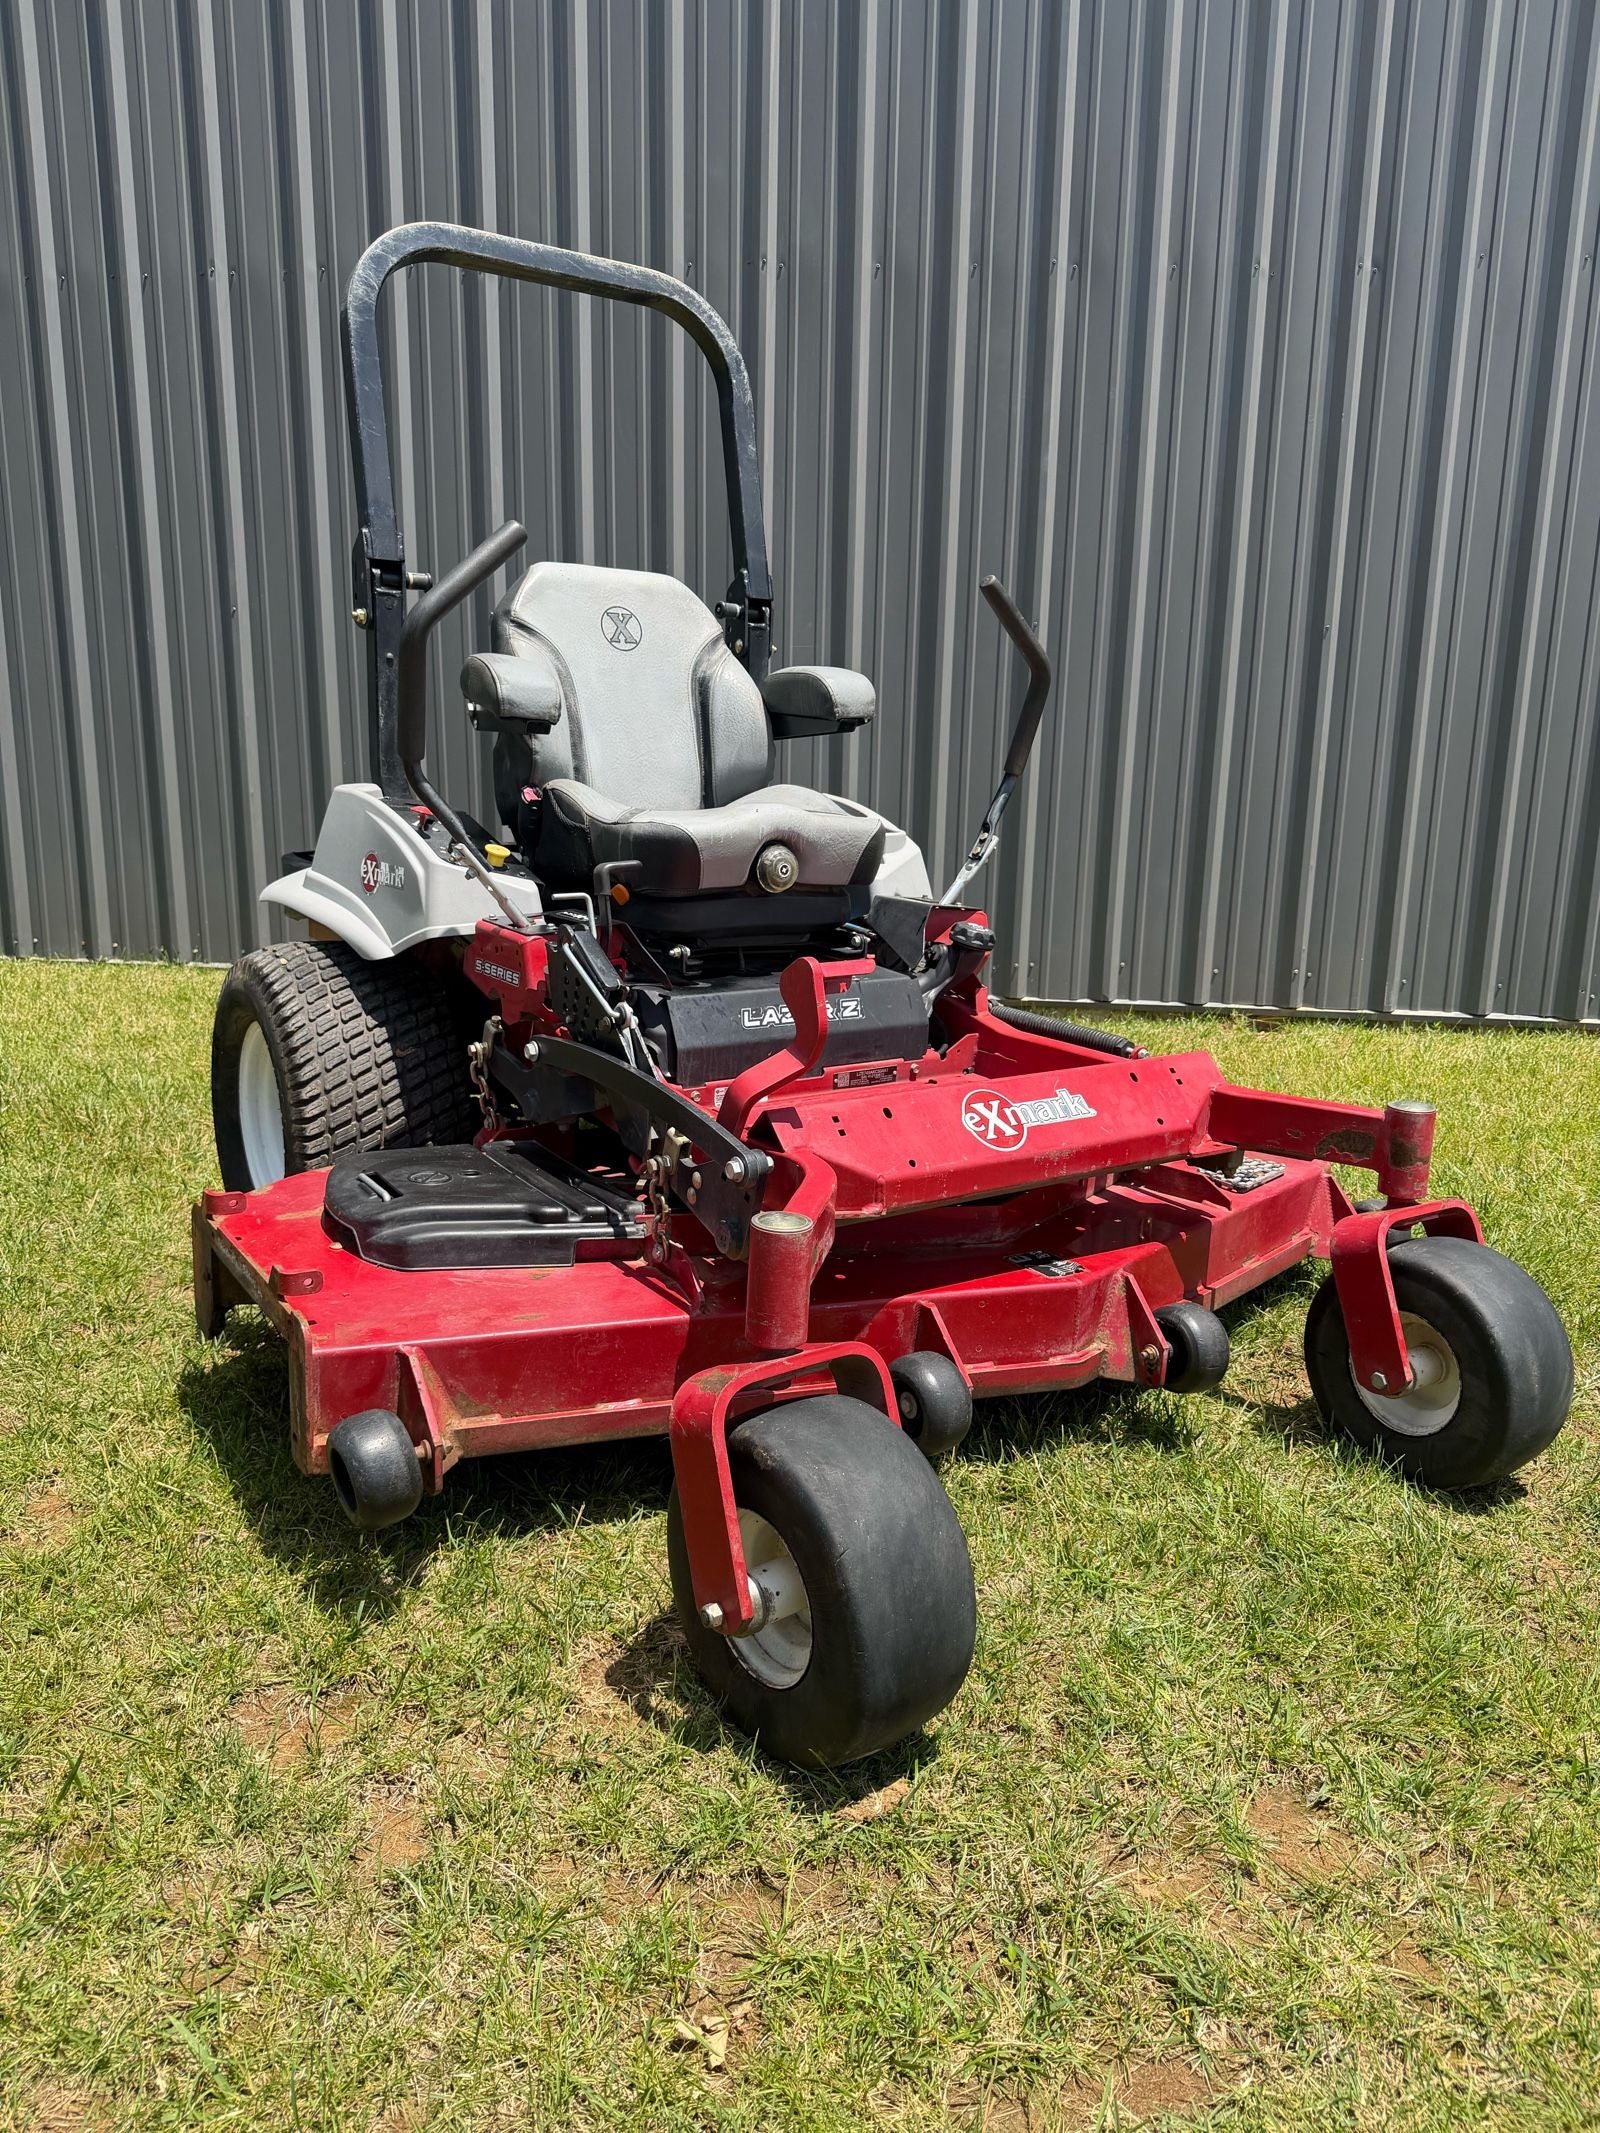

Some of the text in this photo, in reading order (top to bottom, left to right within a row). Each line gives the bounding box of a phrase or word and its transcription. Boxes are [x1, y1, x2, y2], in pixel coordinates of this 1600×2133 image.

[606, 611, 638, 645] X
[475, 959, 520, 985] S-SERIES
[743, 1000, 835, 1028] LAZR
[964, 1089, 1090, 1140] eXmark
